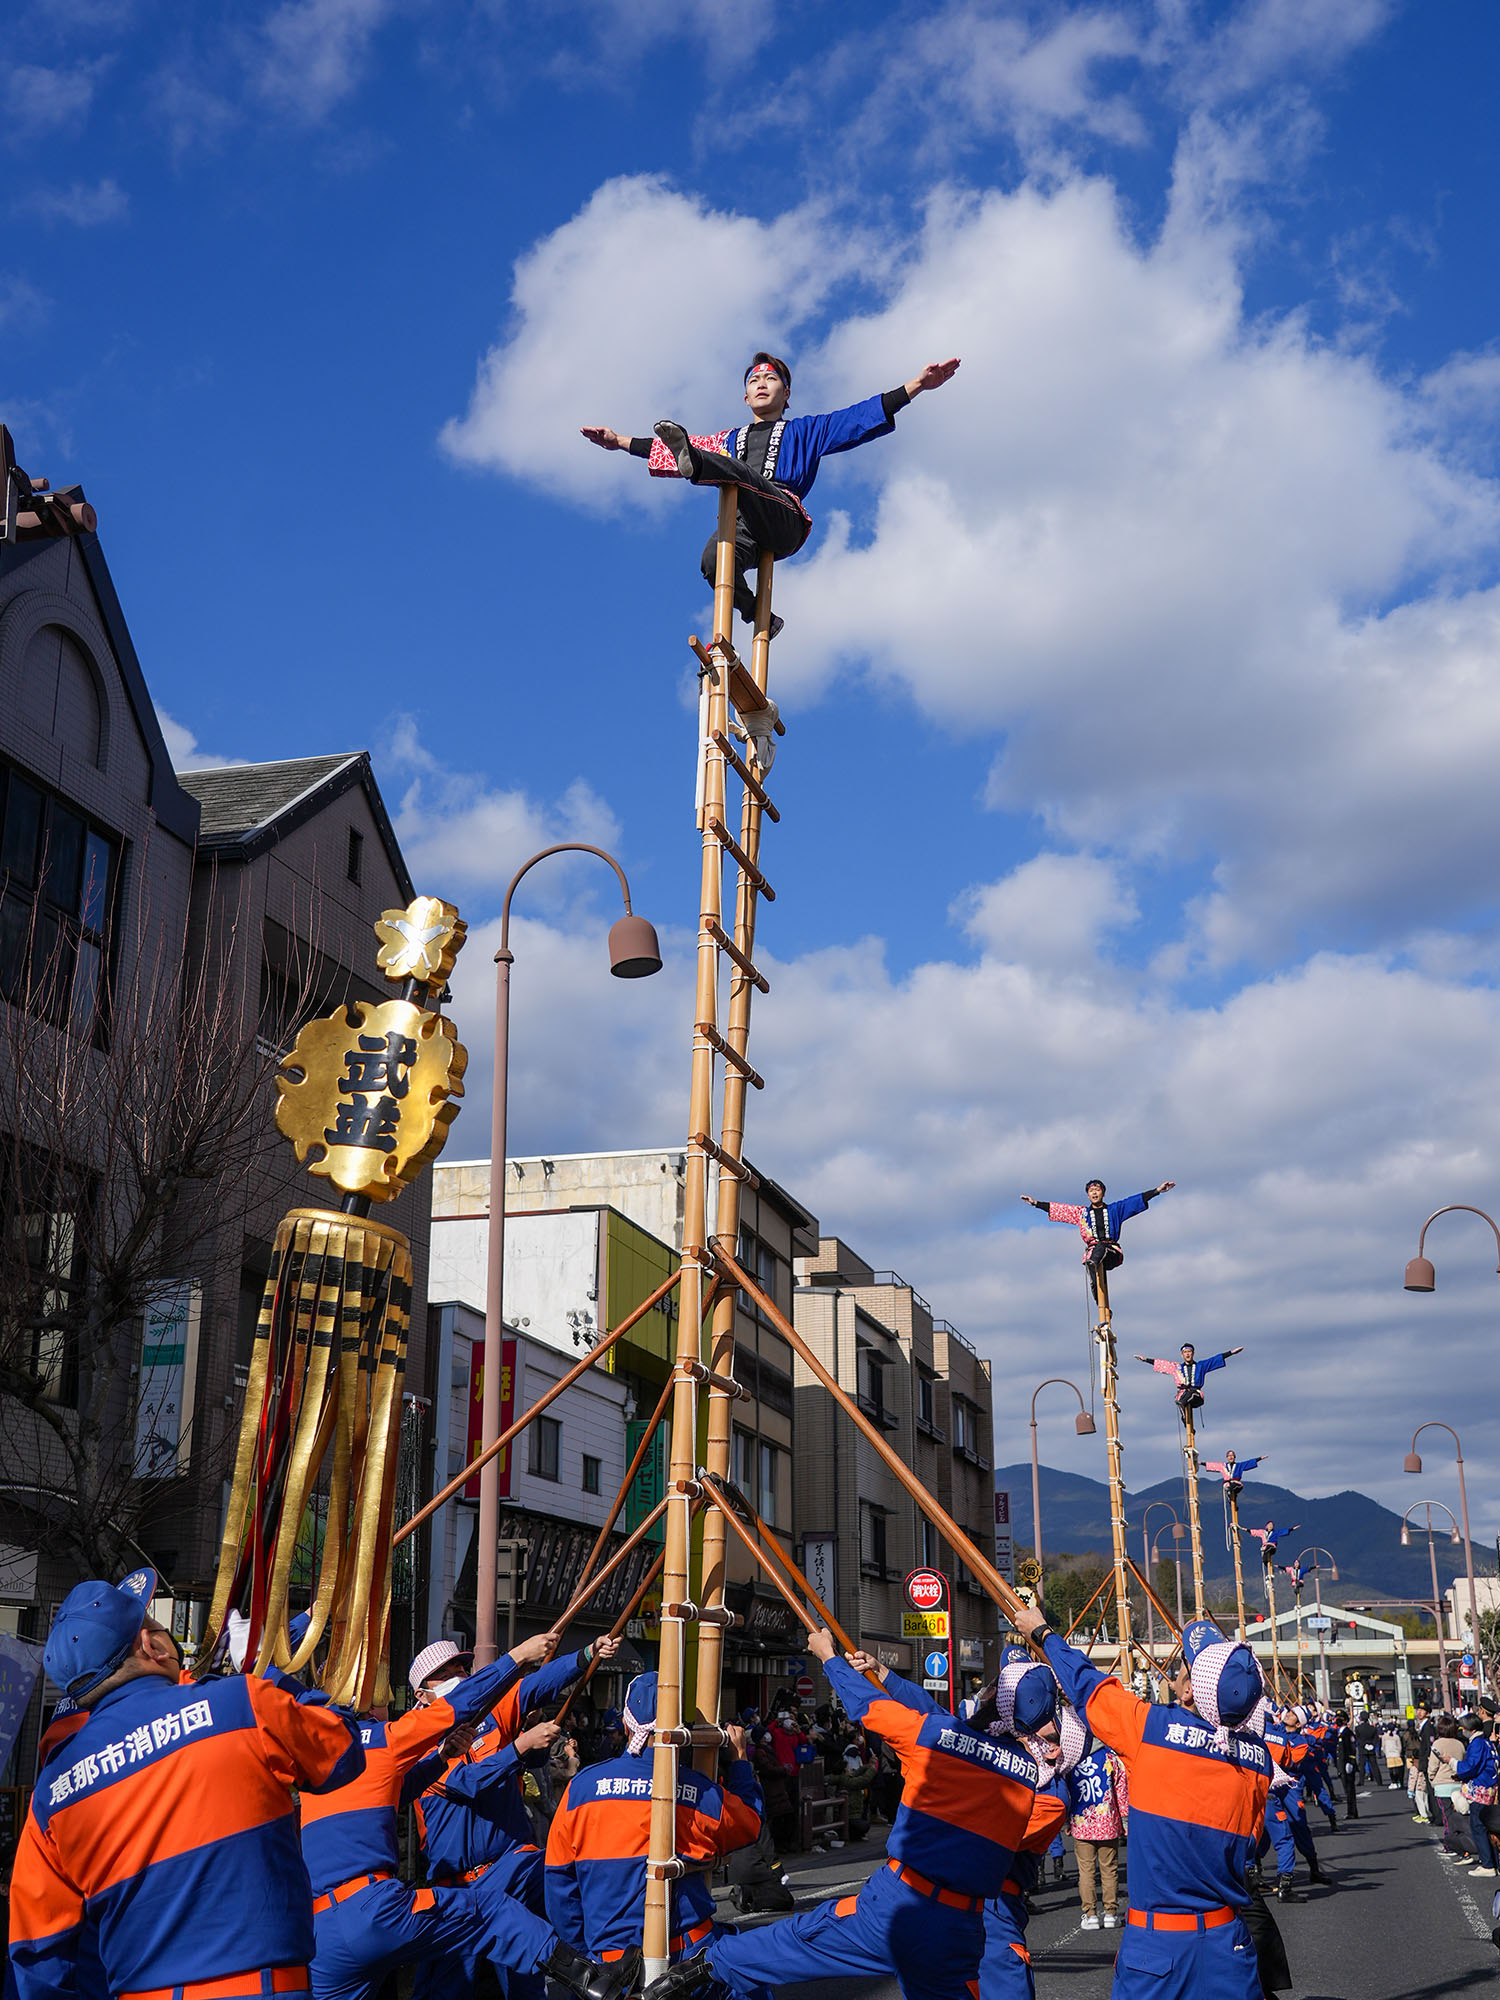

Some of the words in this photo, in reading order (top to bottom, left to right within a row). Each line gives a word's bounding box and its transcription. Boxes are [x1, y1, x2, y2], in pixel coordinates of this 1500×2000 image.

[324, 1031, 418, 1153] 武並
[912, 1584, 939, 1598] 消火栓
[904, 1618, 936, 1632] Bar46
[49, 1699, 214, 1806] 恵那市消防団
[937, 1728, 1039, 1783] 恵那市消防団
